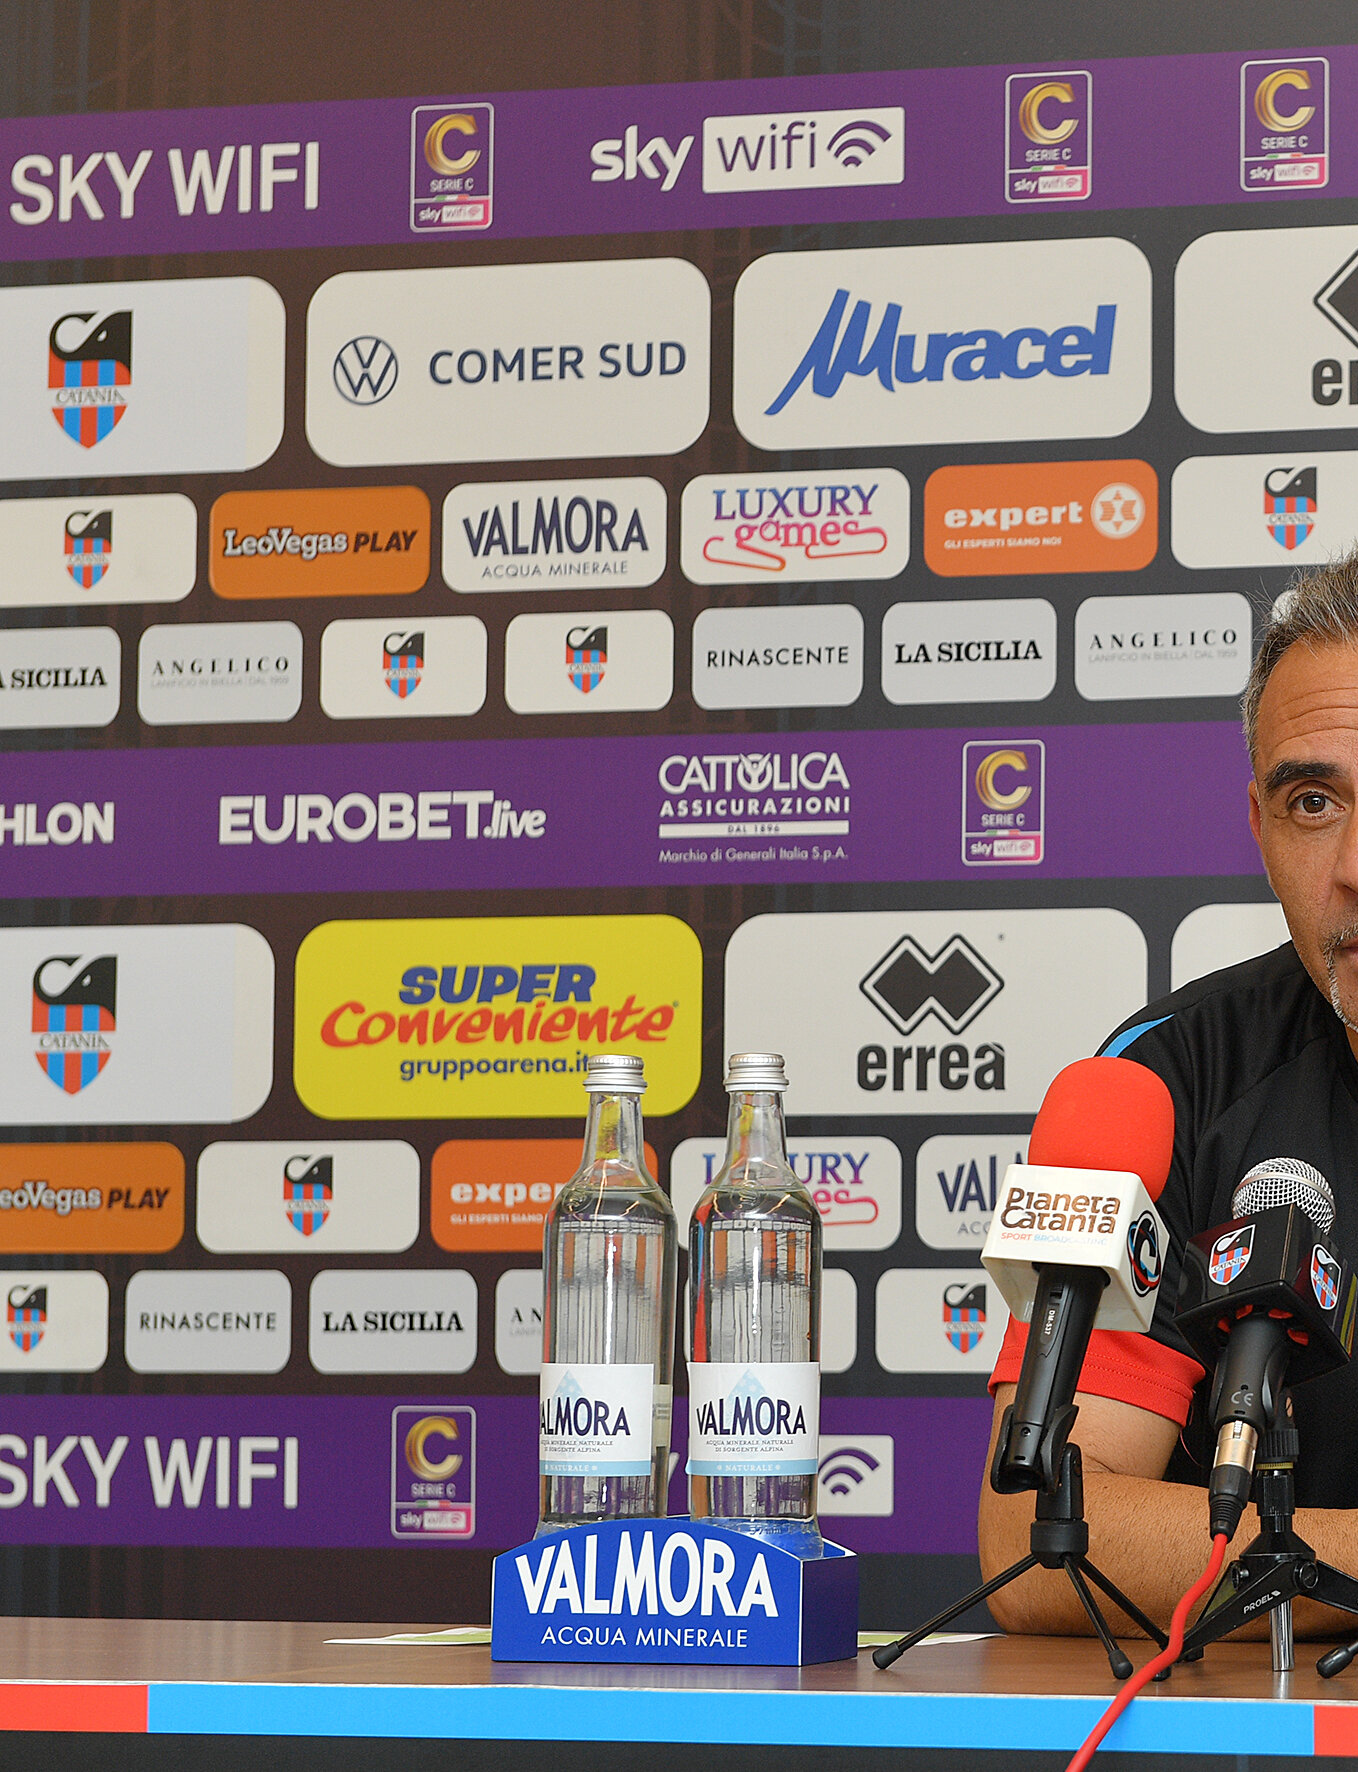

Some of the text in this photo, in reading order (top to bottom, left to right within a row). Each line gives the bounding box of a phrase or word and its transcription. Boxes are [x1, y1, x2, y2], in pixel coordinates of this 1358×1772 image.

[1261, 135, 1309, 150] SERIE C
[589, 121, 818, 192] sky wifi
[1025, 148, 1072, 162] SERIE C
[9, 141, 320, 225] SKY WIFI
[430, 178, 474, 192] SERIE C
[429, 341, 687, 385] COMER SUD
[763, 288, 1117, 416] Muracel
[55, 387, 126, 406] CATANIA
[712, 483, 879, 521] LUXURY
[461, 495, 650, 558] VALMORA
[944, 500, 1083, 531] expert
[223, 527, 418, 561] LeoVegas PLAY
[482, 560, 629, 580] ACQUA MINERALE
[1090, 629, 1237, 649] ANGELICO
[706, 646, 849, 668] RINASCENTE
[894, 639, 1042, 664] LA SICILIA
[152, 656, 289, 676] ANGELICO
[10, 666, 108, 690] SICILIA
[658, 751, 851, 795] CATTOLICA
[660, 796, 850, 818] ASSICURAZIONI
[981, 813, 1025, 827] SERIE C
[659, 848, 708, 863] Marchio
[710, 847, 722, 861] di
[725, 846, 776, 861] Generali
[780, 845, 808, 860] Italia
[398, 964, 597, 1005] SUPER
[320, 994, 675, 1049] Conveniente
[38, 1032, 109, 1050] CATANIA
[0, 1181, 170, 1216] eoVegas PLAY
[1005, 1187, 1121, 1215] Pianeta
[1000, 1206, 1116, 1234] Catania
[1000, 1231, 1032, 1241] SPORT
[139, 1311, 277, 1331] RINASCENTE
[323, 1311, 464, 1332] LA SICILIA
[1231, 1391, 1254, 1407] CE
[540, 1397, 631, 1436] ALMORA
[696, 1396, 807, 1436] VALMORA
[0, 1434, 299, 1510] SKY WIFI
[725, 1464, 774, 1472] NATURALE
[411, 1484, 456, 1497] SERIE C
[515, 1530, 779, 1617] VALMORA
[1243, 1593, 1274, 1615] PROEL
[541, 1625, 749, 1648] ACQUA MINERALE
